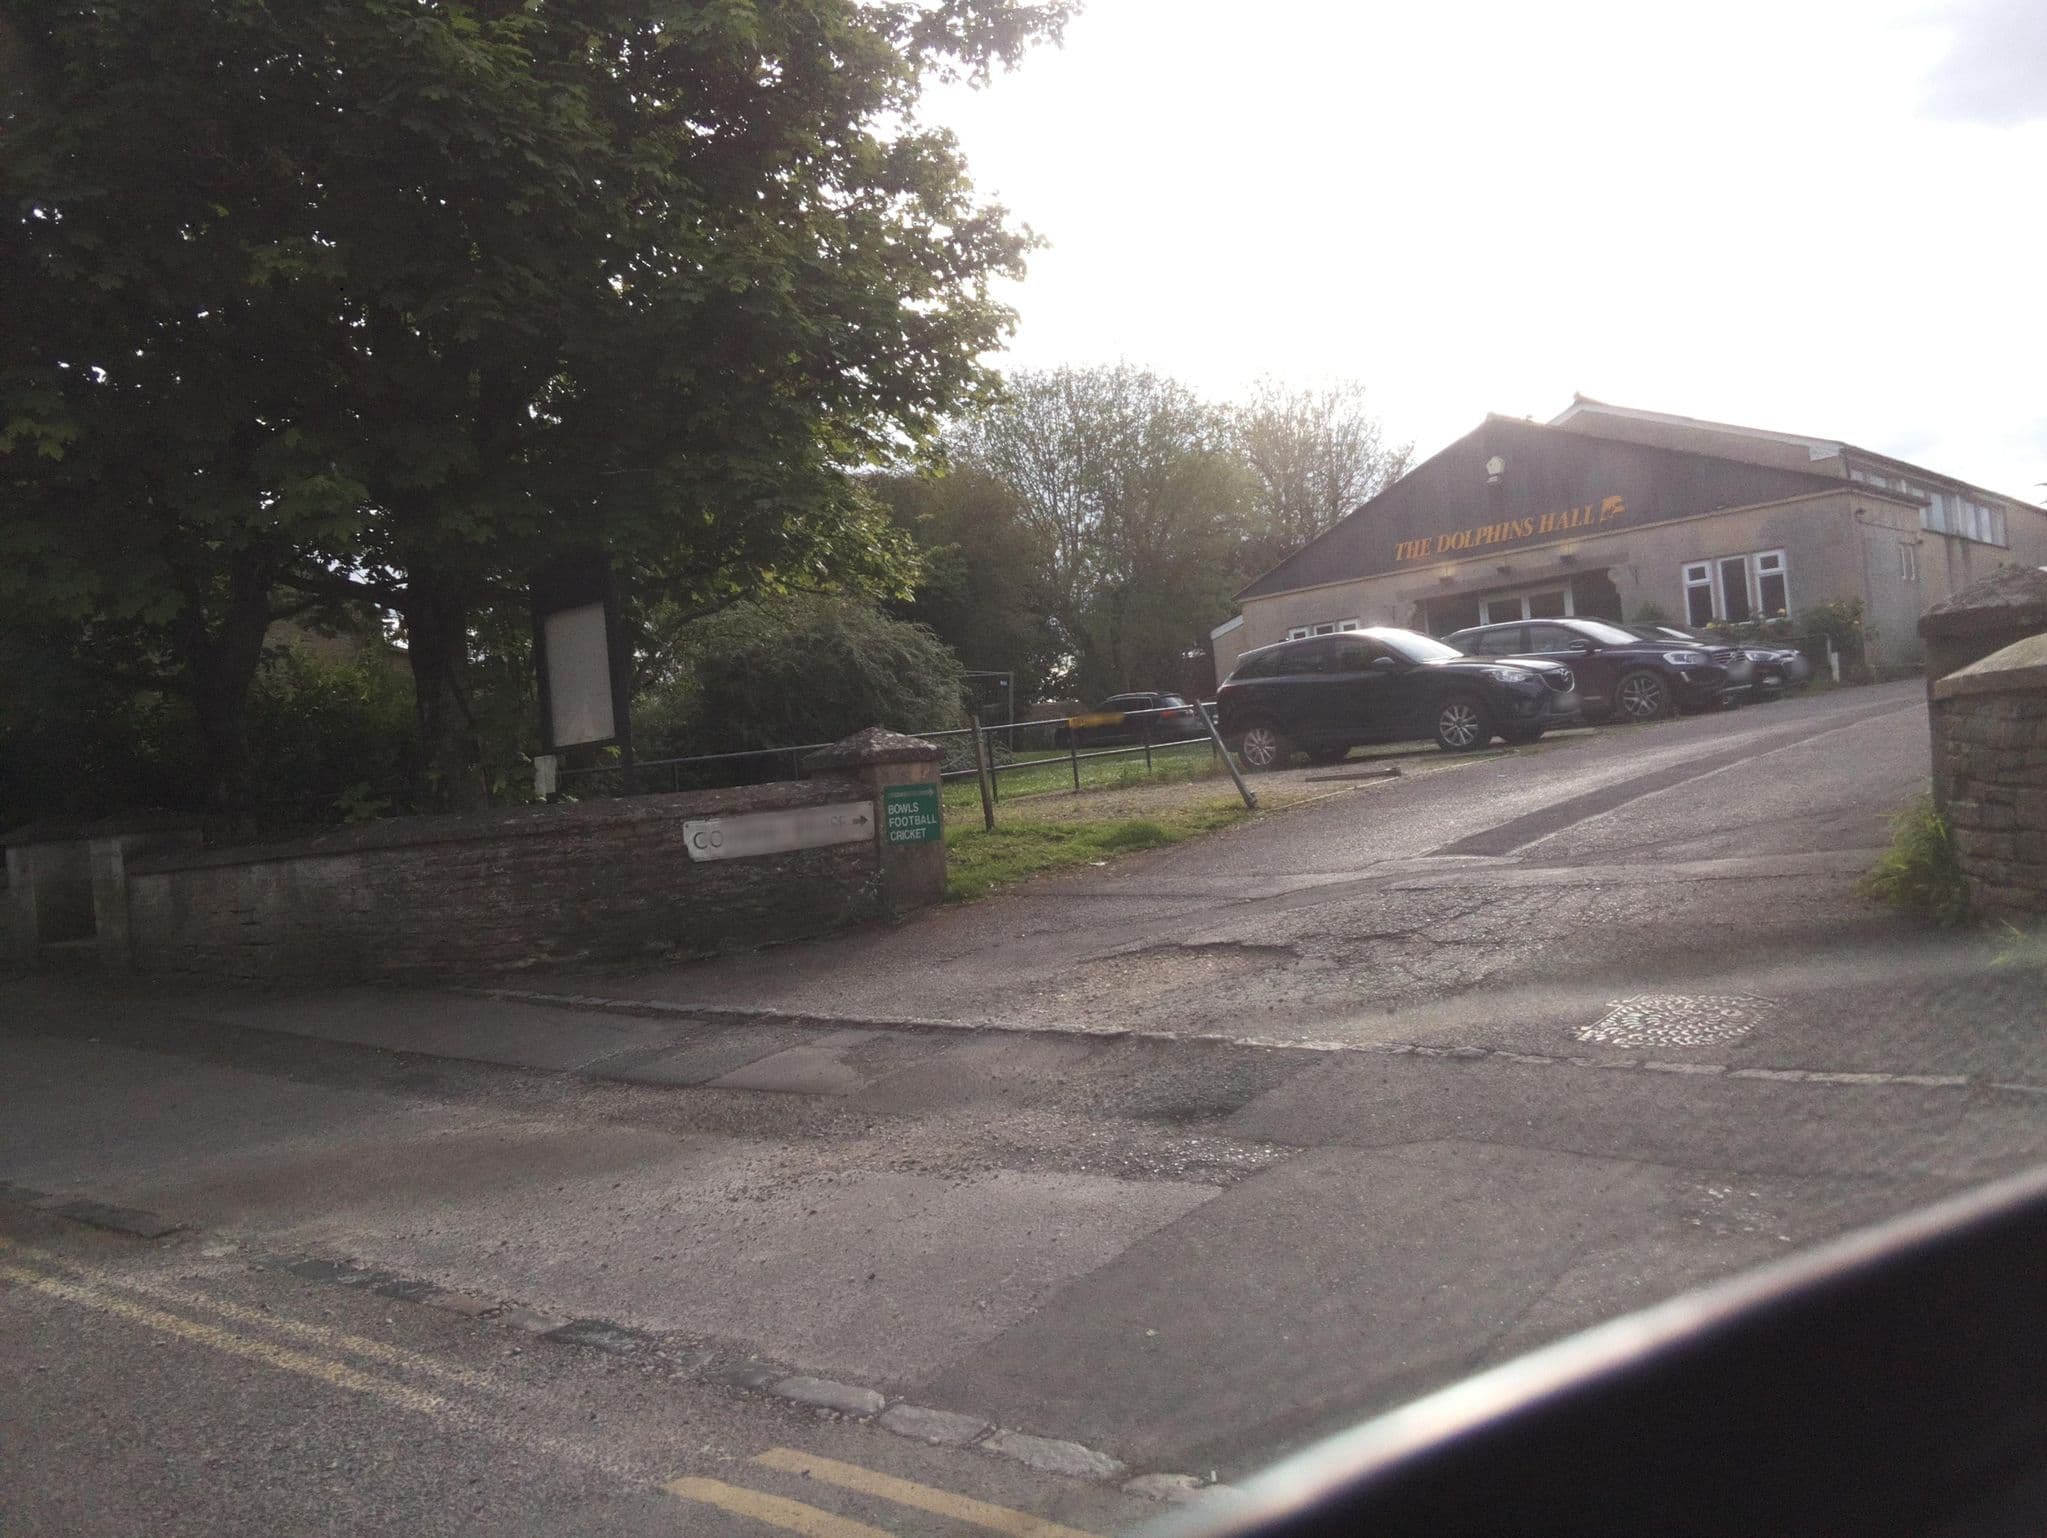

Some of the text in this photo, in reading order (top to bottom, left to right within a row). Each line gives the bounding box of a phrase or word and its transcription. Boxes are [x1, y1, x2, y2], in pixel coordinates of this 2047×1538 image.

[1395, 504, 1595, 561] THE DOLPHINS HALL
[888, 801, 919, 815] BOWLS
[889, 813, 937, 828] FOOTBALL
[890, 828, 926, 841] CRICKET
